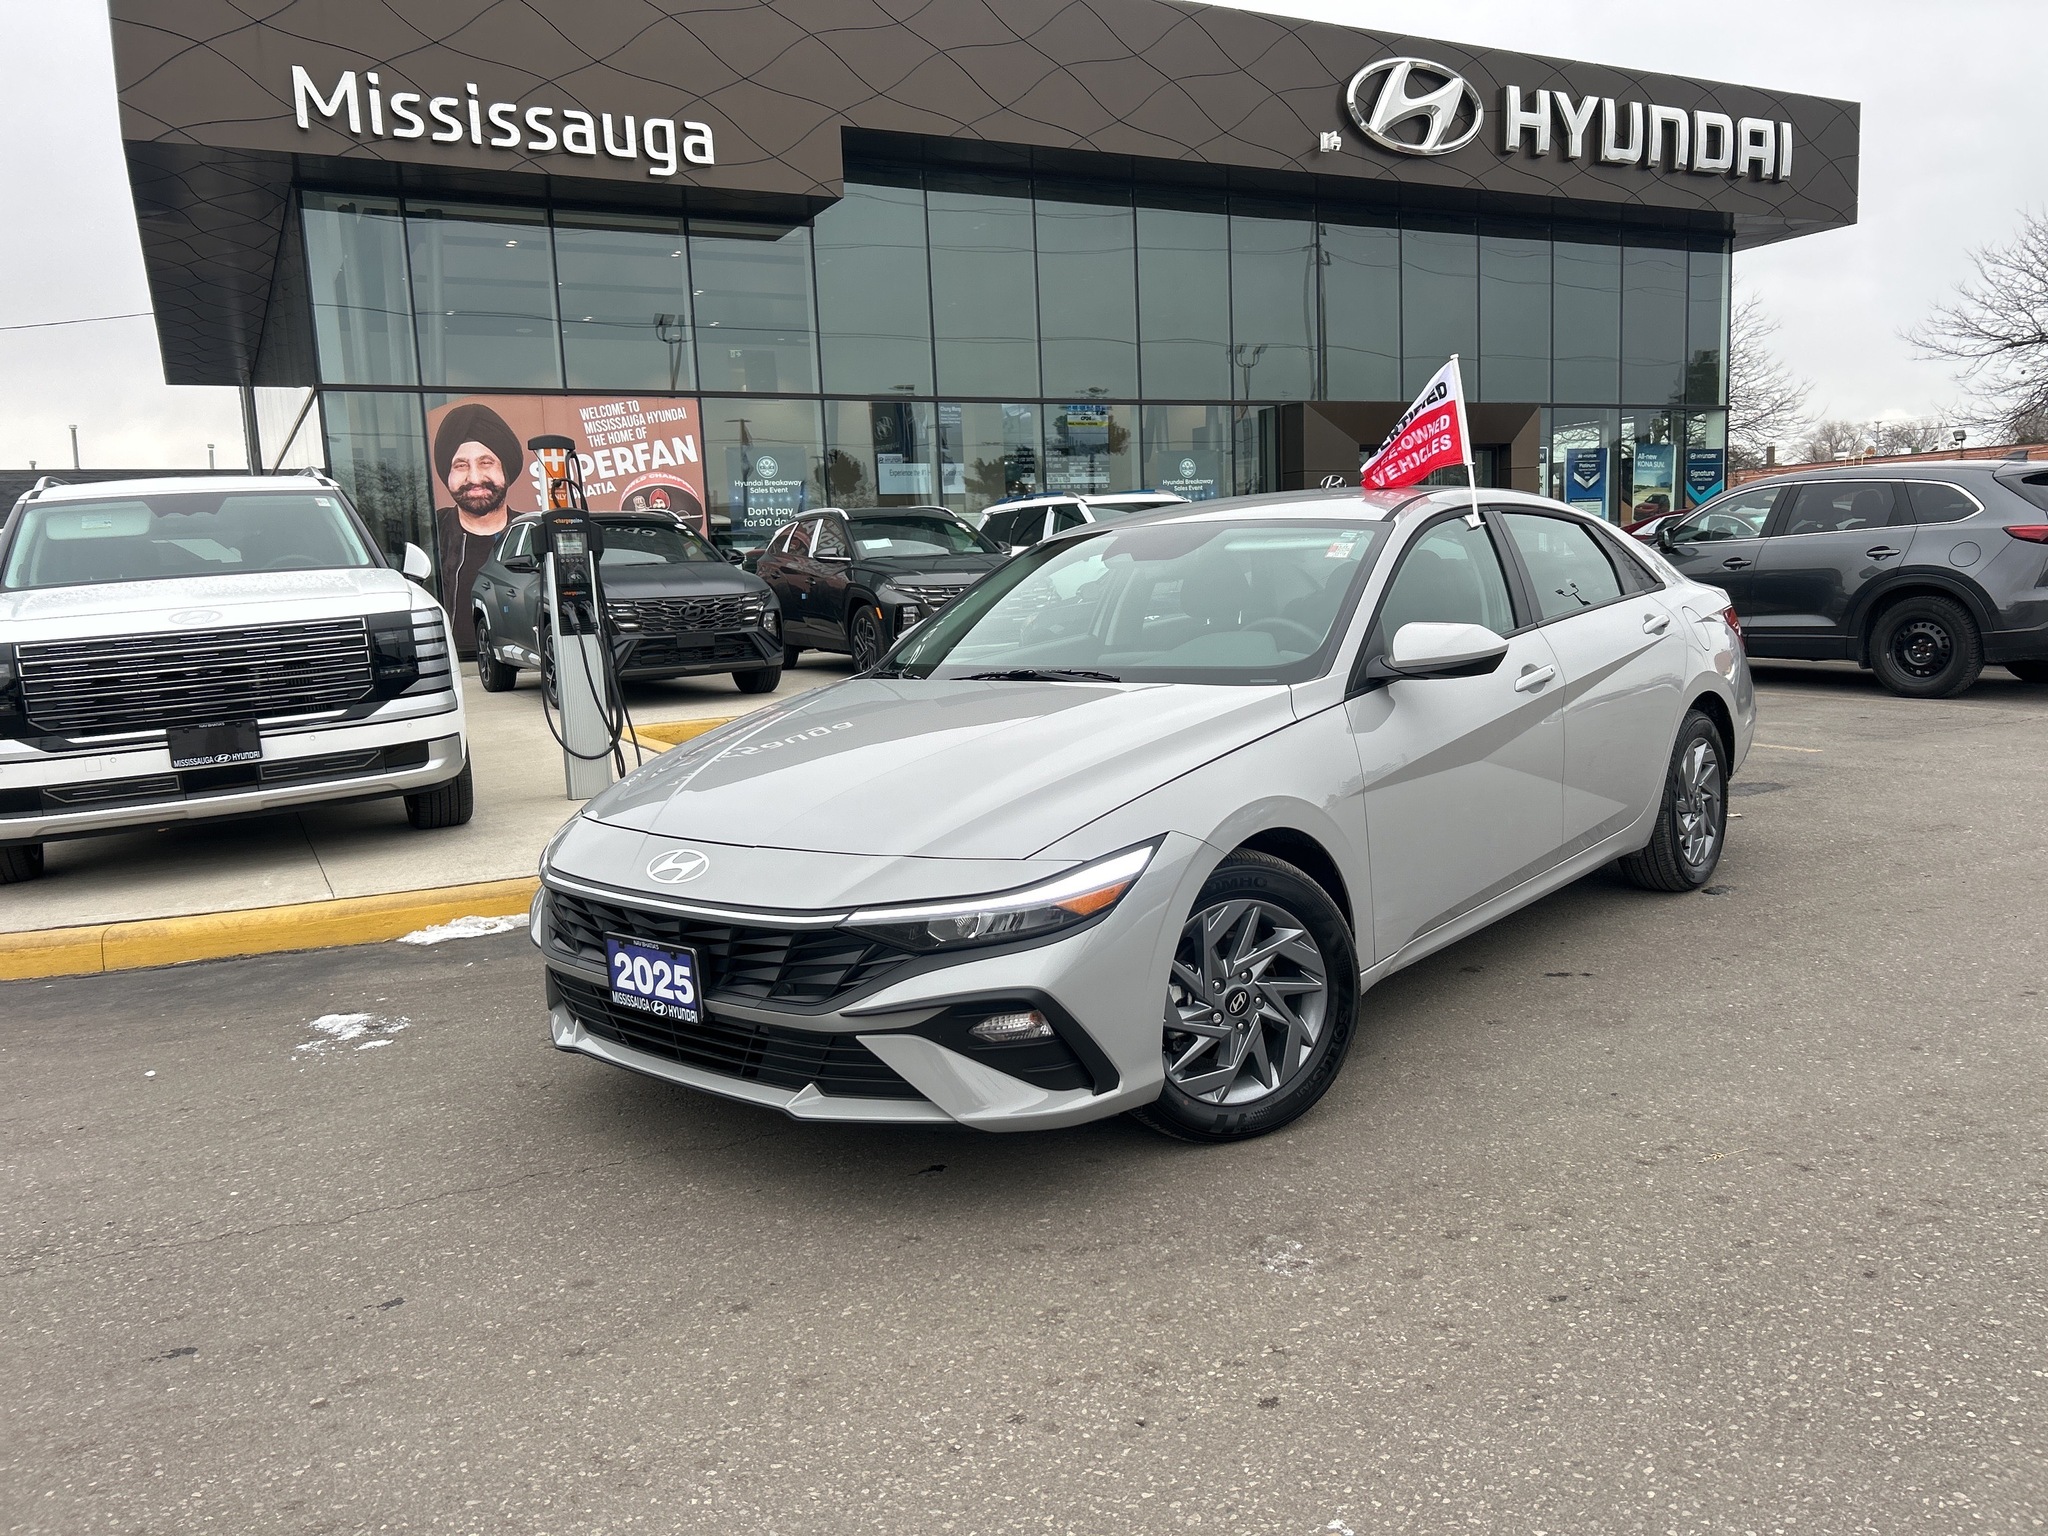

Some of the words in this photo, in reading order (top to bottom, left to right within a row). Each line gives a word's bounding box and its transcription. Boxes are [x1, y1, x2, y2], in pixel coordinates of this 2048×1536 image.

[291, 64, 715, 176] Mississauga
[1505, 84, 1793, 182] HYUNDAI
[579, 402, 626, 420] WELCOME
[626, 400, 640, 413] TO
[583, 413, 646, 434] MISSISSAUGA
[646, 407, 687, 425] HYUNDAI
[587, 433, 607, 448] THE
[607, 429, 635, 445] HOME
[635, 426, 648, 440] OF
[1371, 434, 1452, 487] VEHICLES
[734, 480, 764, 488] Hyundai
[1690, 470, 1715, 478] Signature
[743, 518, 757, 527] for
[759, 518, 772, 527] 90
[747, 507, 774, 516] Don't
[775, 508, 794, 517] pay
[173, 756, 214, 768] MISSISSAUGA
[231, 751, 260, 761] HYUNDAI
[614, 952, 695, 1004] 2025
[612, 990, 651, 1012] MISSISSAUGA
[667, 1004, 699, 1024] HYUNDAI
